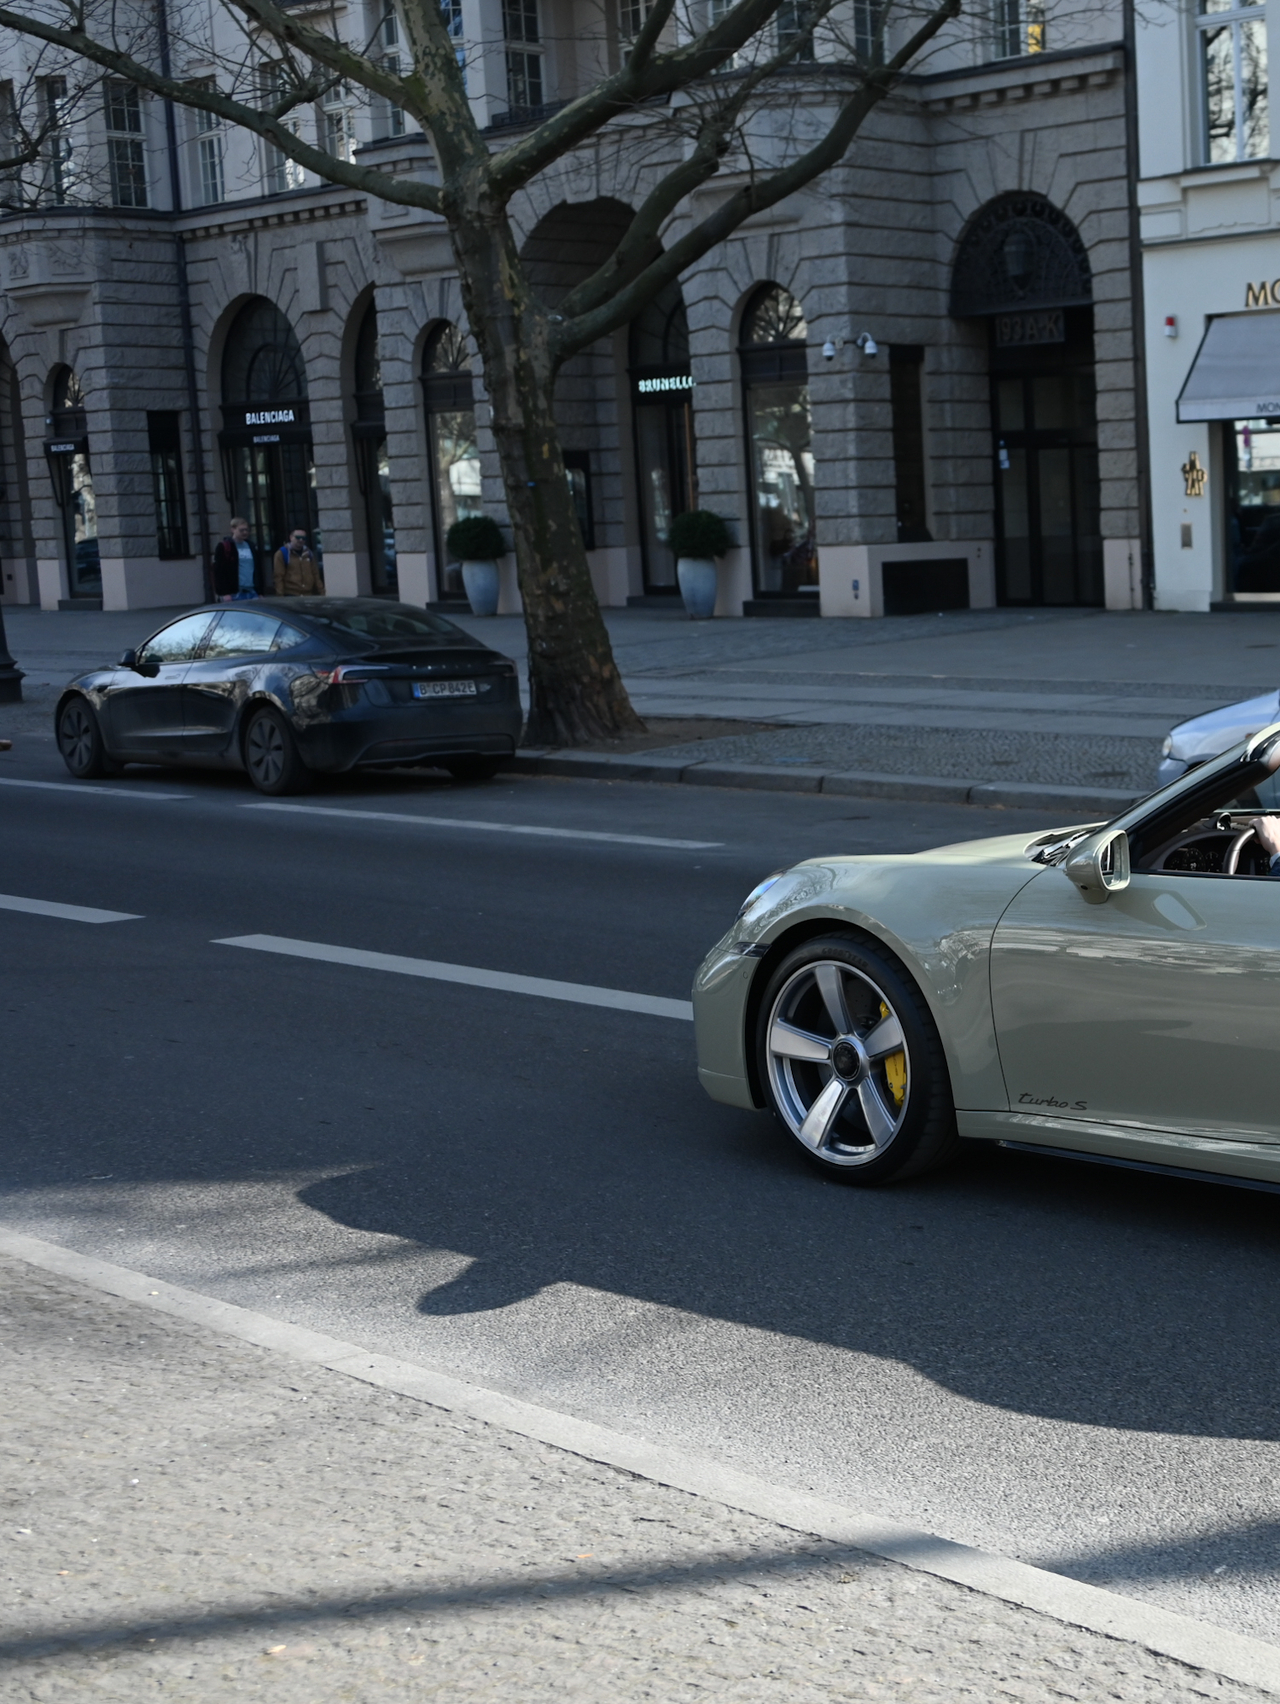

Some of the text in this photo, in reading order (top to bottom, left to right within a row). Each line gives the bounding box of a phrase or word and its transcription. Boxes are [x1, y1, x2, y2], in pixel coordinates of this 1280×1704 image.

[245, 409, 295, 425] BALENCIAGA
[1018, 1092, 1087, 1111] turbo S
